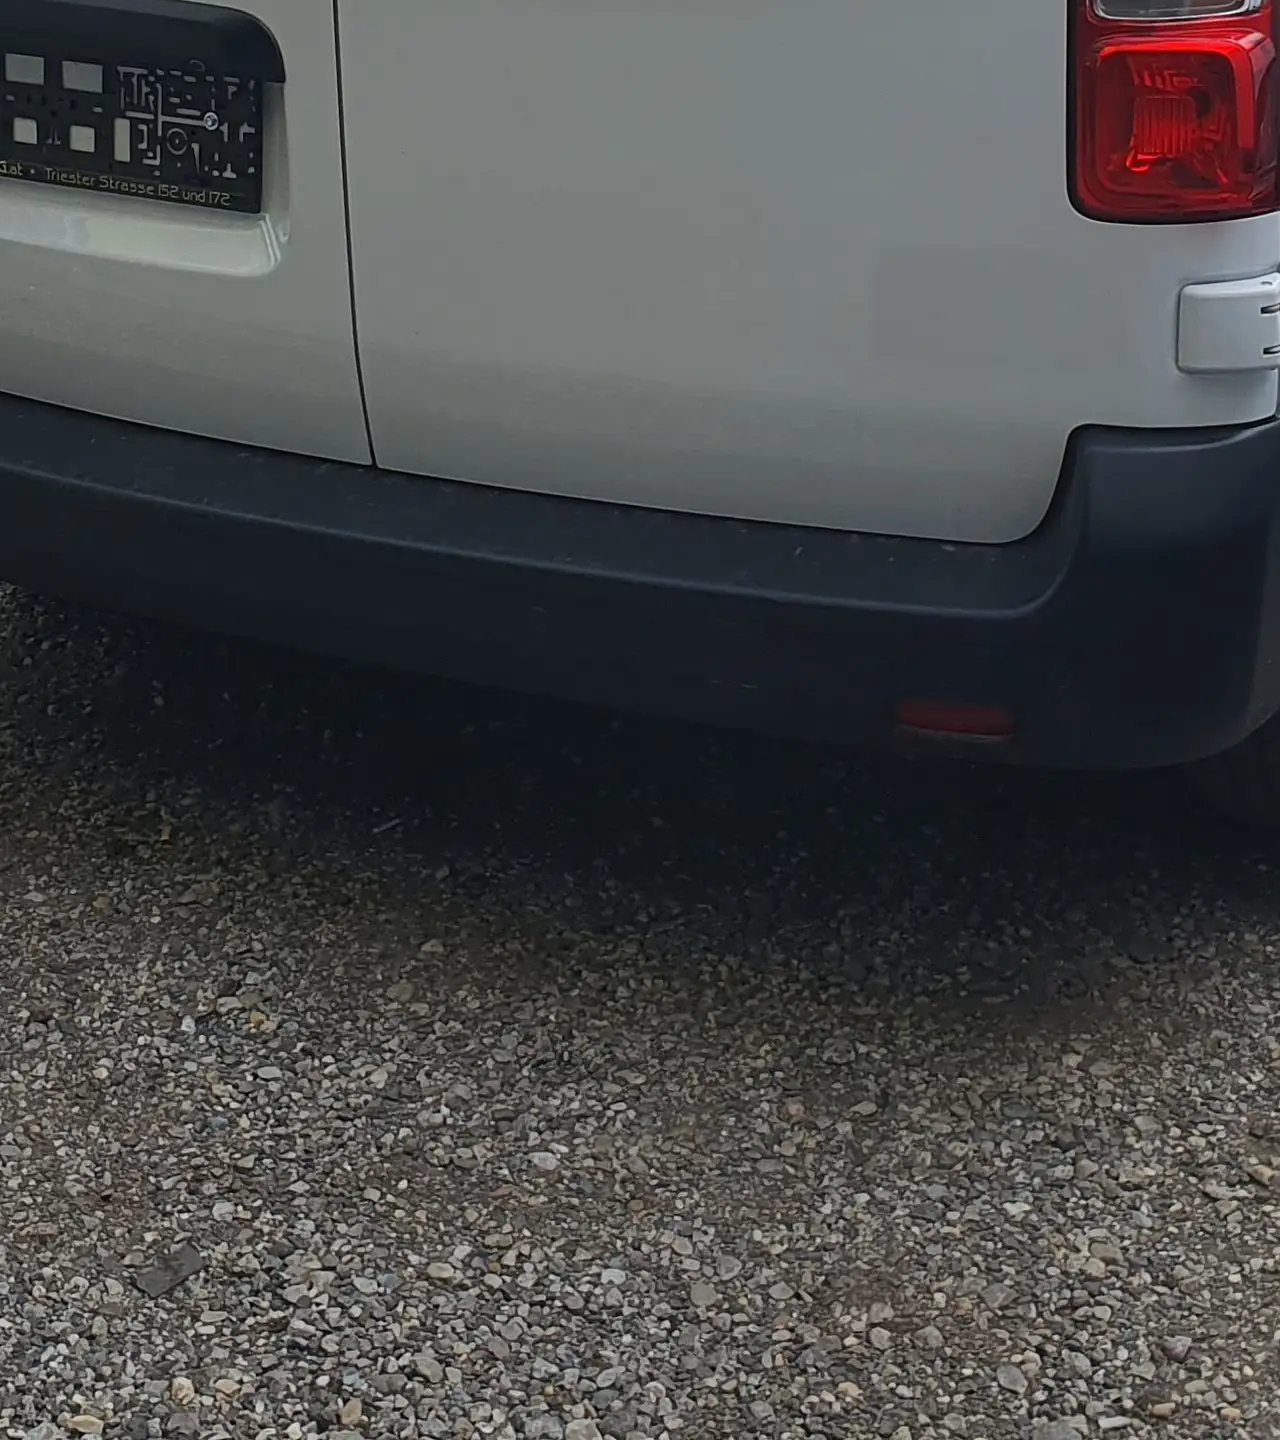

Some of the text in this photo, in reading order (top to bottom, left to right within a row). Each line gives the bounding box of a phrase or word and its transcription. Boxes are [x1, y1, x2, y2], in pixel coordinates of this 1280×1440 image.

[45, 167, 96, 186] Triester
[99, 175, 155, 196] Strasse
[182, 190, 206, 203] und
